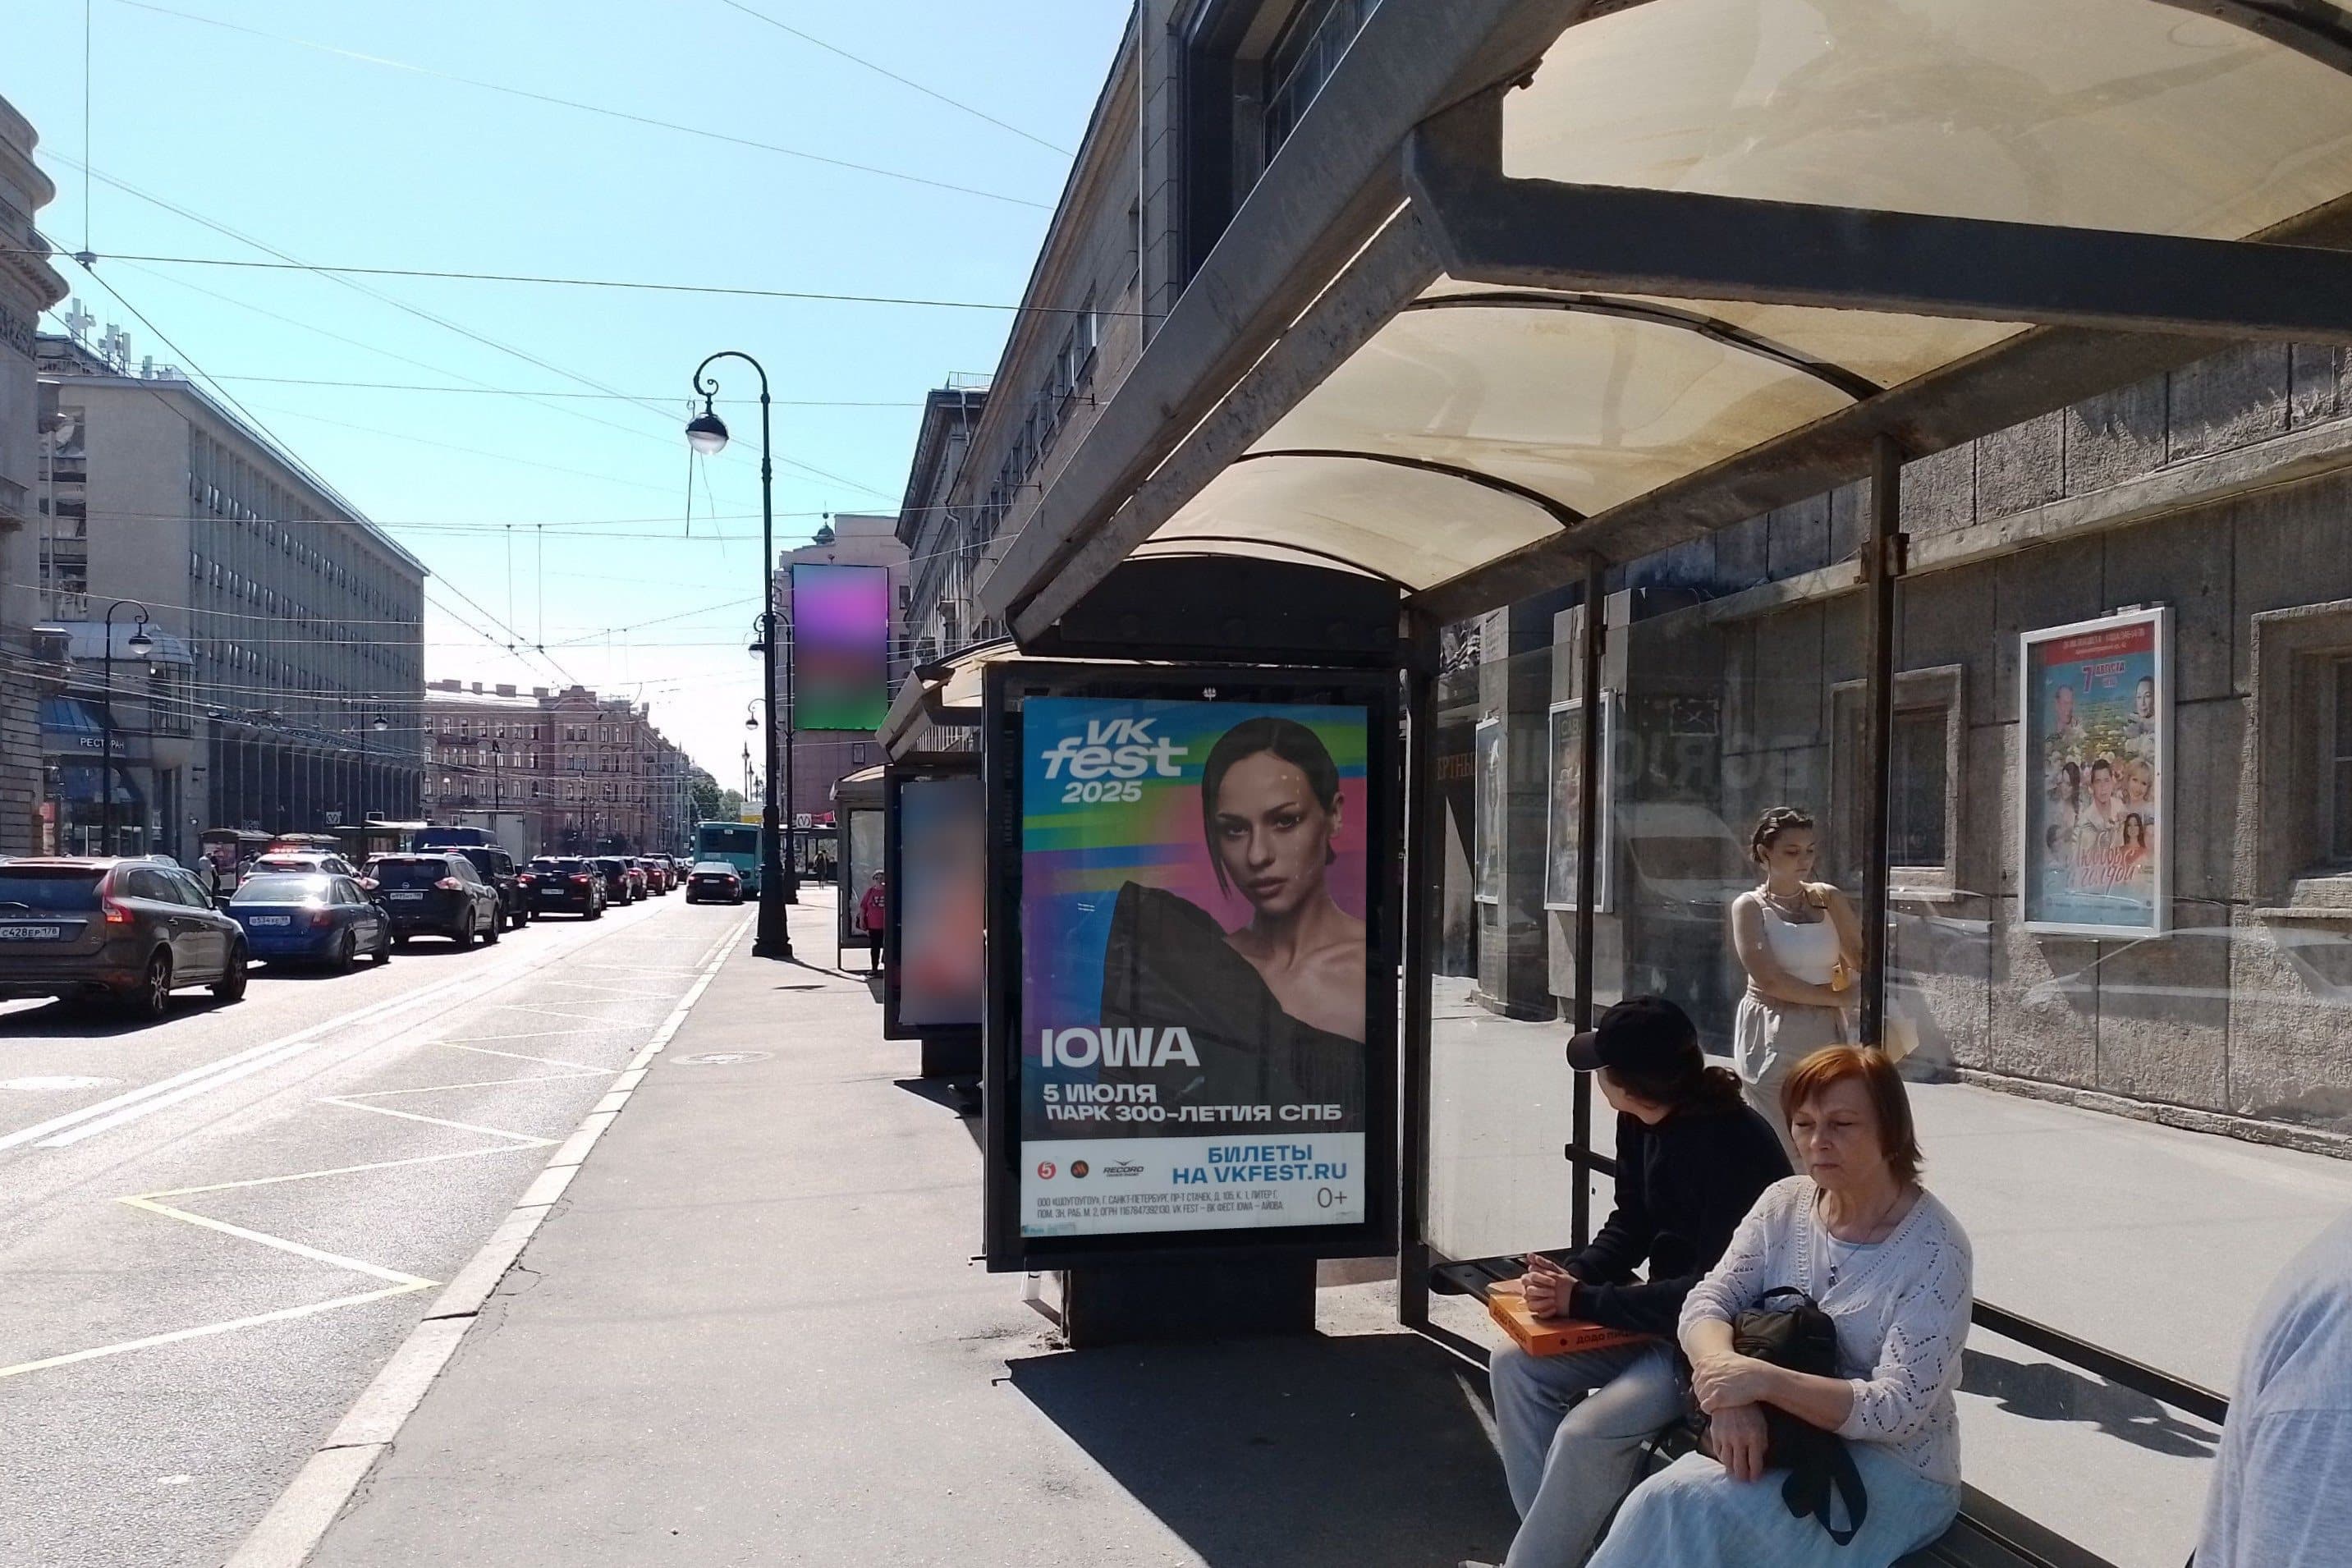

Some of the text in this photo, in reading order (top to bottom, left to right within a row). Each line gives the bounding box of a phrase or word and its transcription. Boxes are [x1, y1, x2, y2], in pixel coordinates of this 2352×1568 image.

[1087, 718, 1158, 745] VK
[80, 737, 125, 750] РЕСТРАН
[1041, 736, 1189, 780] fest
[1061, 781, 1143, 804] 2025
[1041, 1026, 1200, 1068] IOWA
[1043, 1084, 1157, 1103] 5 ИЮЛЯ
[1046, 1104, 1343, 1123] ПАРК 300-ЛЕТИЯ СПБ
[1208, 1144, 1313, 1164] БИЛЕТЫ
[1103, 1166, 1144, 1174] RECORD
[1172, 1163, 1348, 1185] НА VKFEST.RU
[1037, 1198, 1051, 1207] ООО
[1317, 1186, 1348, 1208] 0+
[1101, 1207, 1117, 1216] ОГРН
[1183, 1204, 1199, 1213] FEST
[1576, 1334, 1605, 1345] ДОДО
